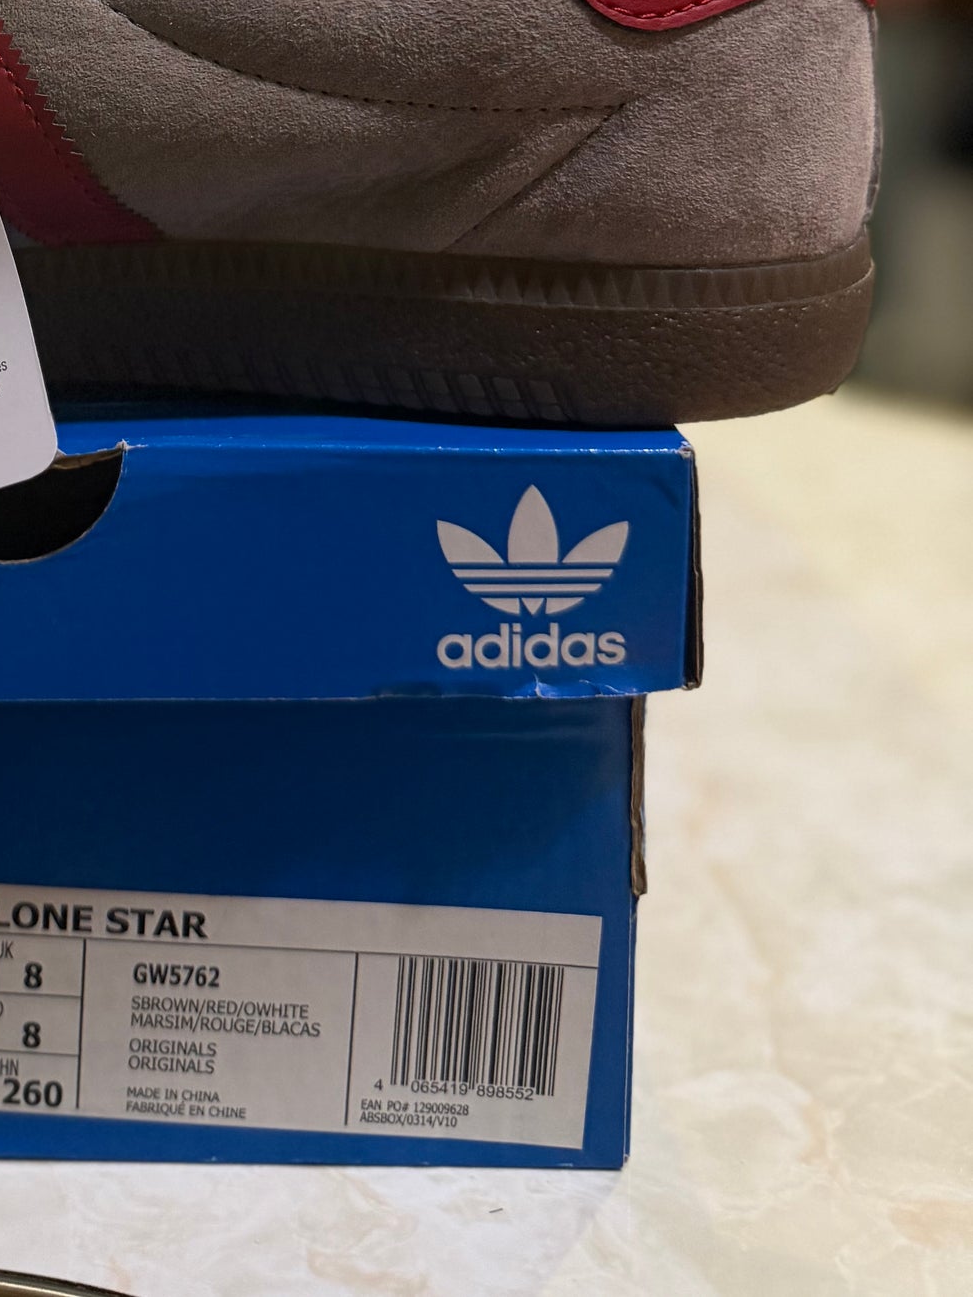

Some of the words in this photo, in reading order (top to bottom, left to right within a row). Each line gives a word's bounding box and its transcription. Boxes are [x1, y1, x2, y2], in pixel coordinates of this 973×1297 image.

[436, 622, 626, 669] adidas
[105, 906, 208, 939] STAR
[24, 962, 43, 989] 8
[133, 962, 220, 989] GW5762
[131, 995, 309, 1020] SBROWN/RED/OWHITE
[22, 1021, 41, 1049] 8
[130, 1012, 321, 1038] MARSIM/ROUGE/BLACAS
[129, 1038, 217, 1057] ORIGINALS
[128, 1055, 215, 1075] ORIGINALS
[2, 1078, 63, 1108] 260
[126, 1085, 160, 1100] MADE
[165, 1088, 177, 1100] IN
[182, 1089, 219, 1103] CHINA
[374, 1079, 383, 1091] 4
[411, 1080, 468, 1095] 065419
[476, 1084, 534, 1101] 898552
[189, 1104, 205, 1116] EN
[209, 1106, 246, 1120] CHINE
[360, 1112, 457, 1128] ABSBOX/0314/V10
[361, 1099, 382, 1111] EAN
[387, 1101, 409, 1112] PO#
[414, 1102, 469, 1116] 129009628
